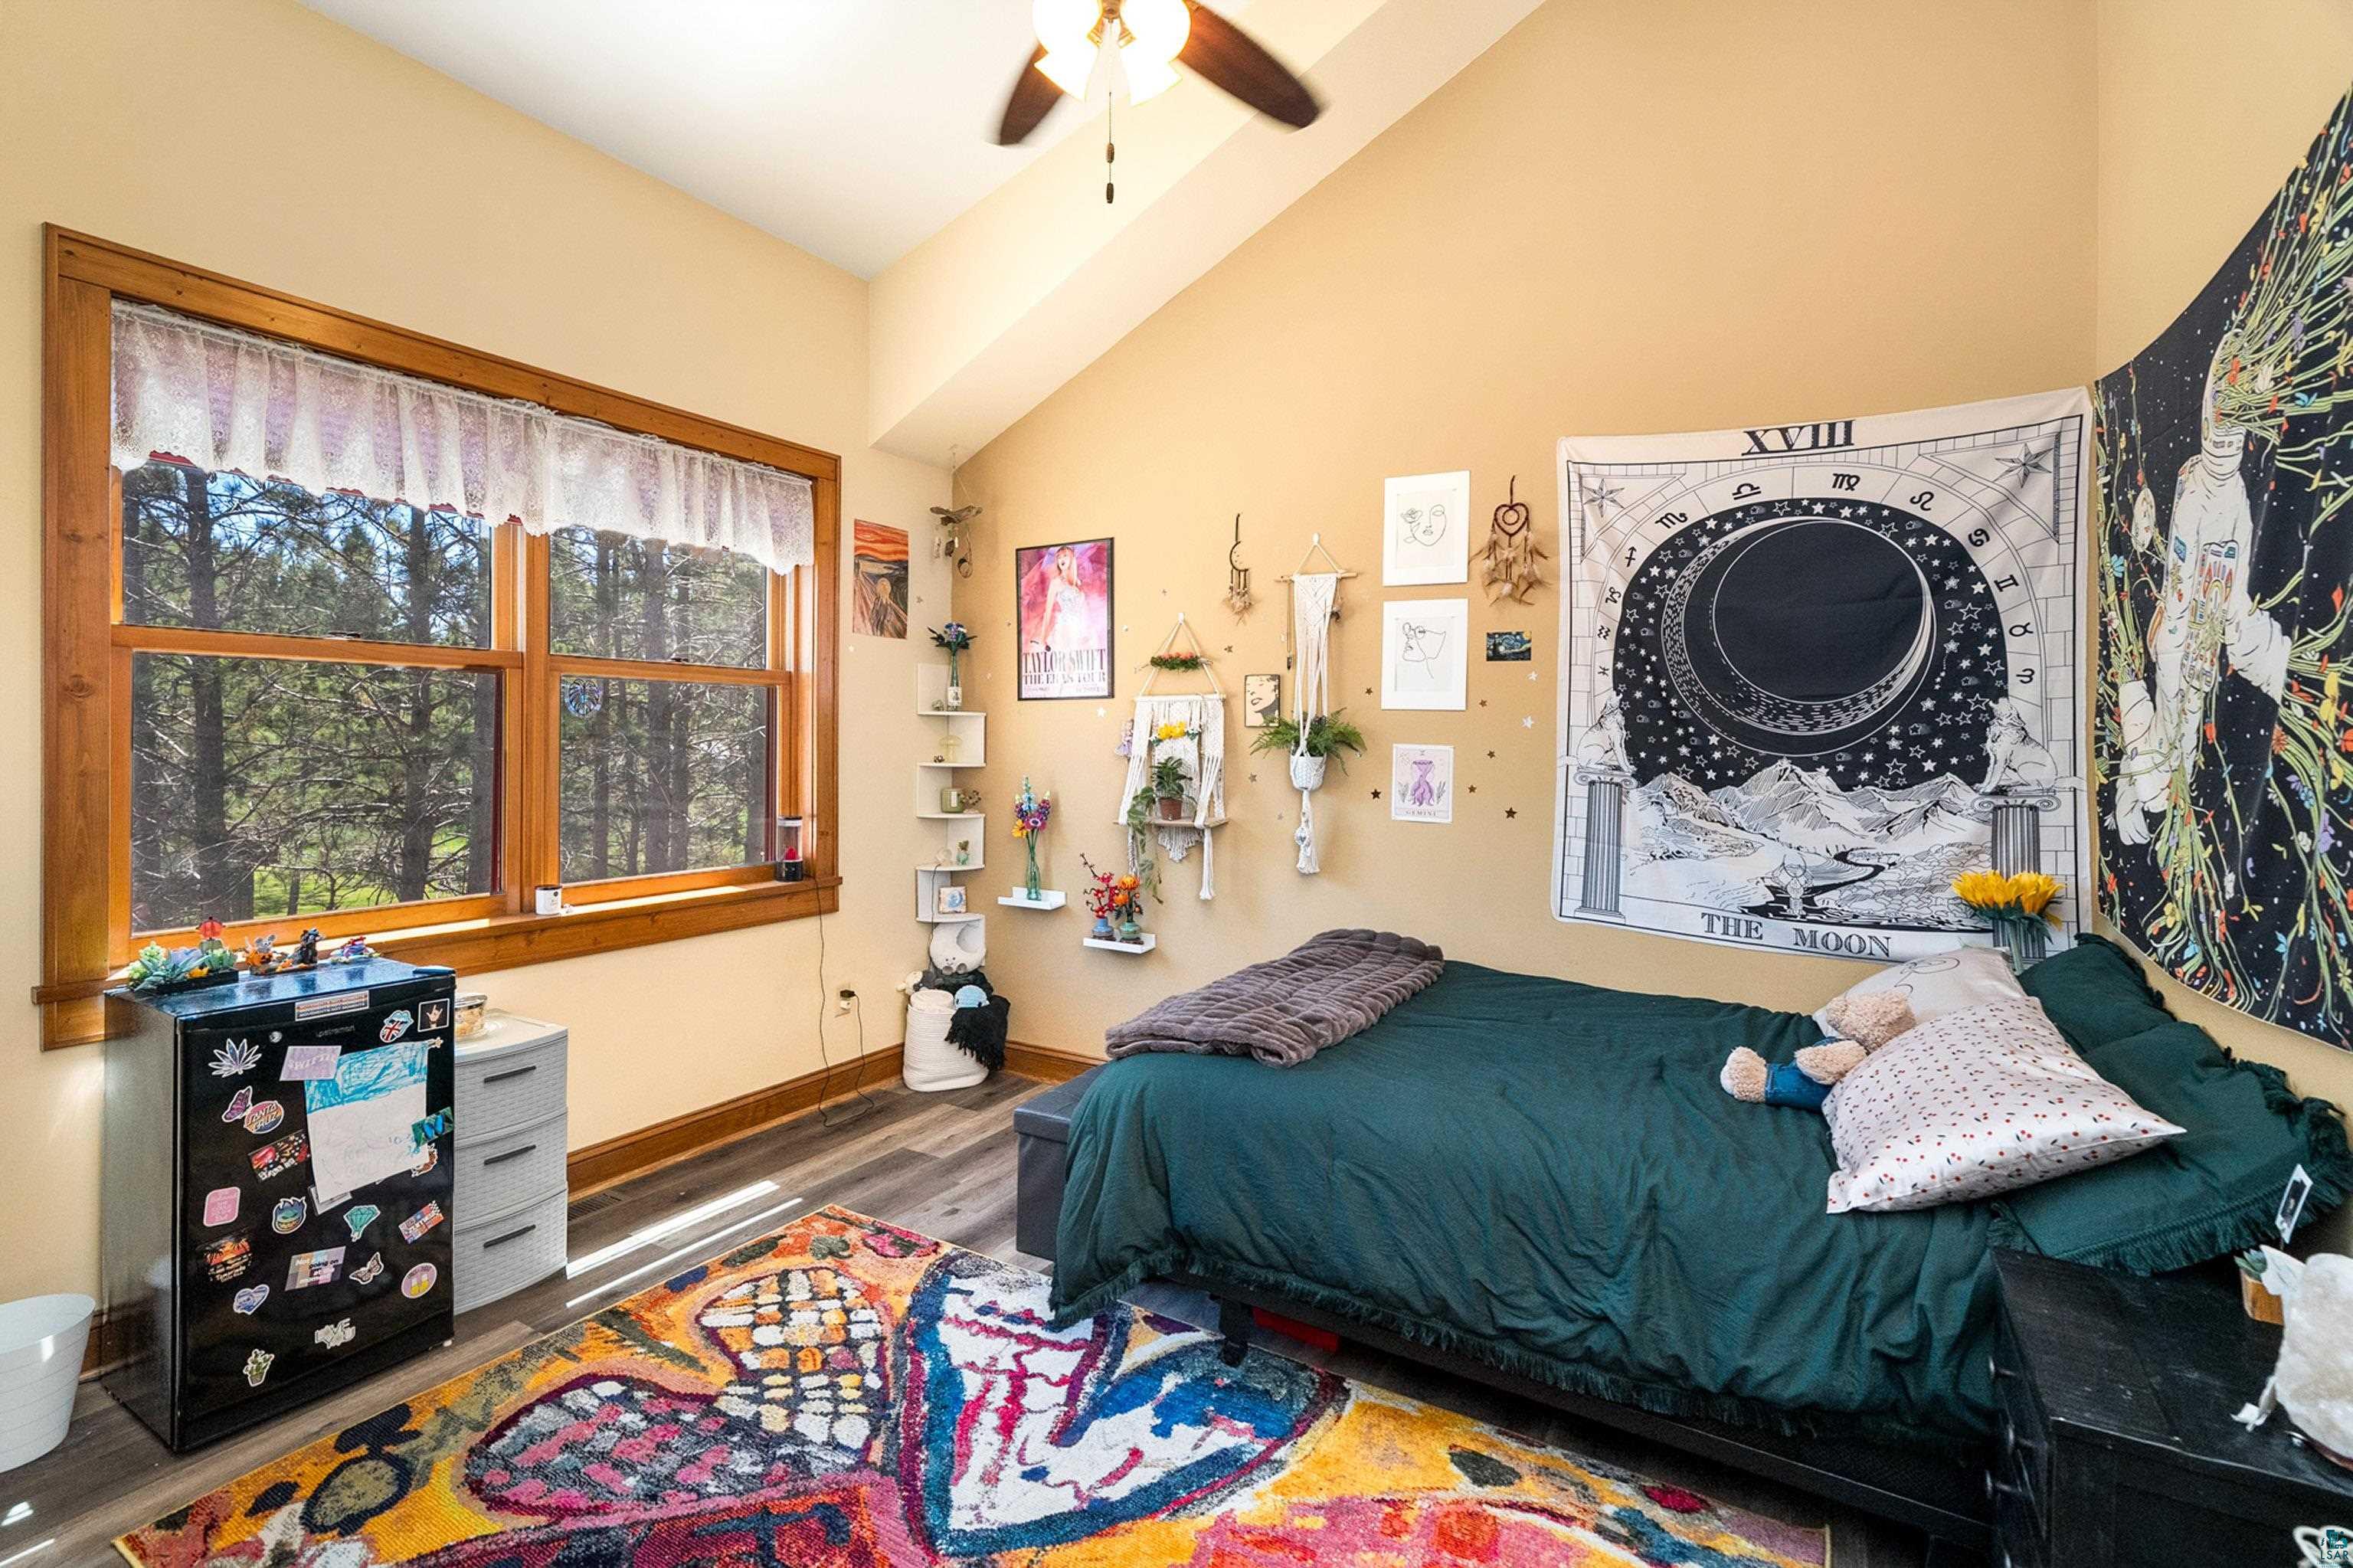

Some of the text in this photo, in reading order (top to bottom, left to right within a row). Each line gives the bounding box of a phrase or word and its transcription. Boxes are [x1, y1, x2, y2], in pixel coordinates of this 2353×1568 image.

[1741, 420, 1855, 456] XVIII
[1023, 649, 1106, 673] TAYLOR SWIFT
[1023, 672, 1106, 685] THE ERAS TOUR
[1701, 912, 1891, 957] THE MOON
